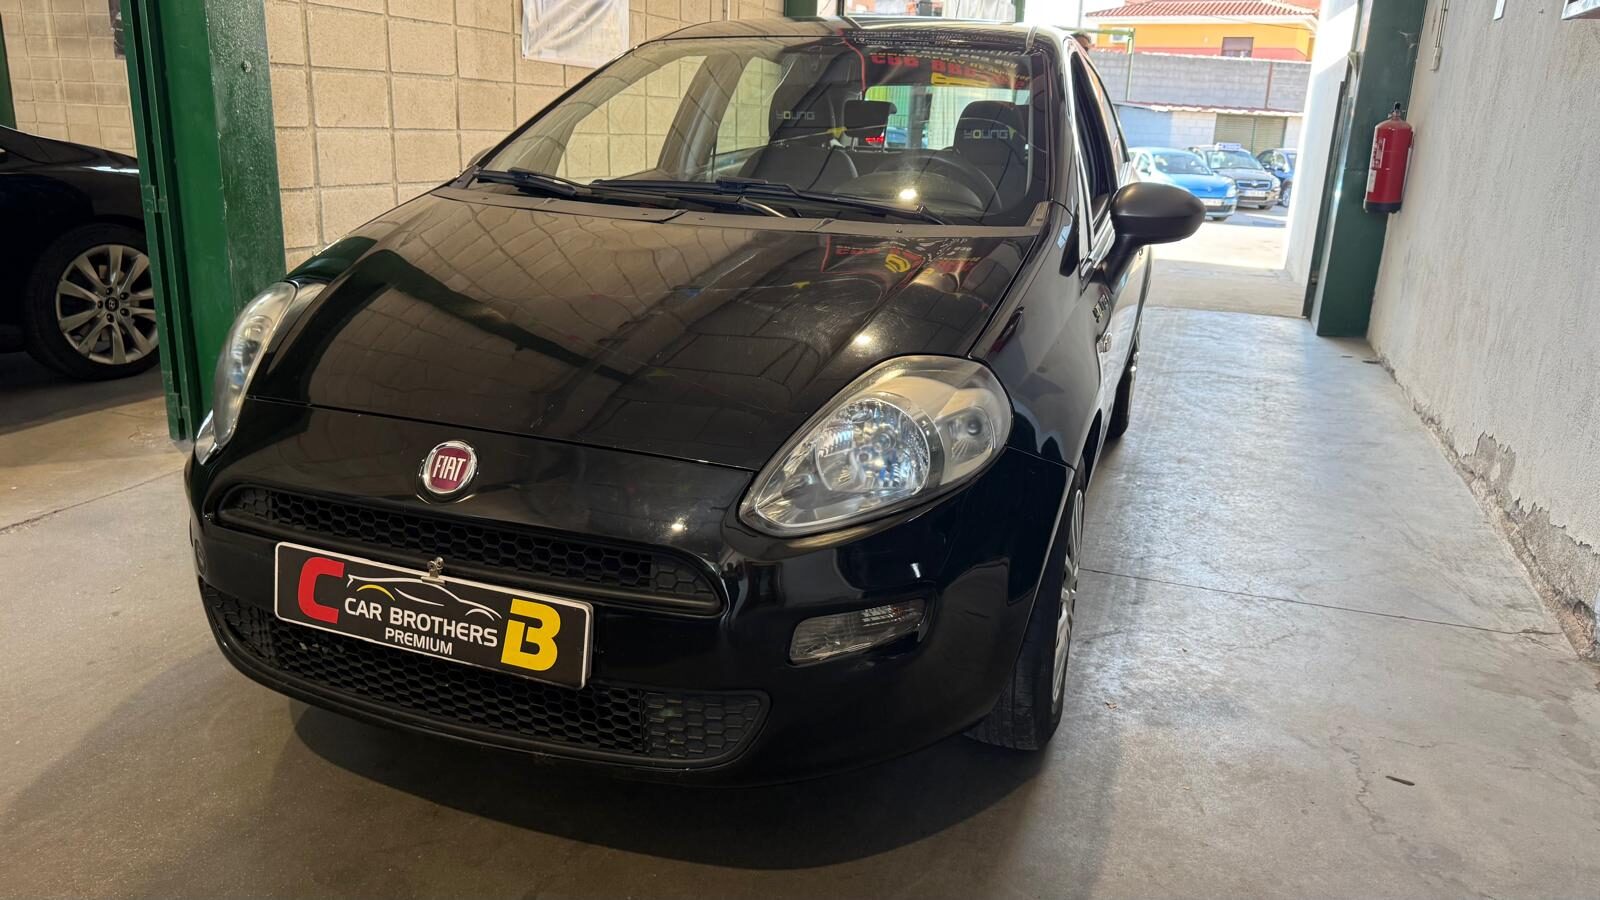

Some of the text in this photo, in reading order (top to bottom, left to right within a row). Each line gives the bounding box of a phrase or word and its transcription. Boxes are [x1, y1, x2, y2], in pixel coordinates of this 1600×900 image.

[432, 455, 466, 482] FIAT
[298, 557, 344, 624] C
[344, 597, 498, 648] CAR BROTHERS
[385, 627, 453, 655] PREMIUM
[501, 598, 561, 671] B
